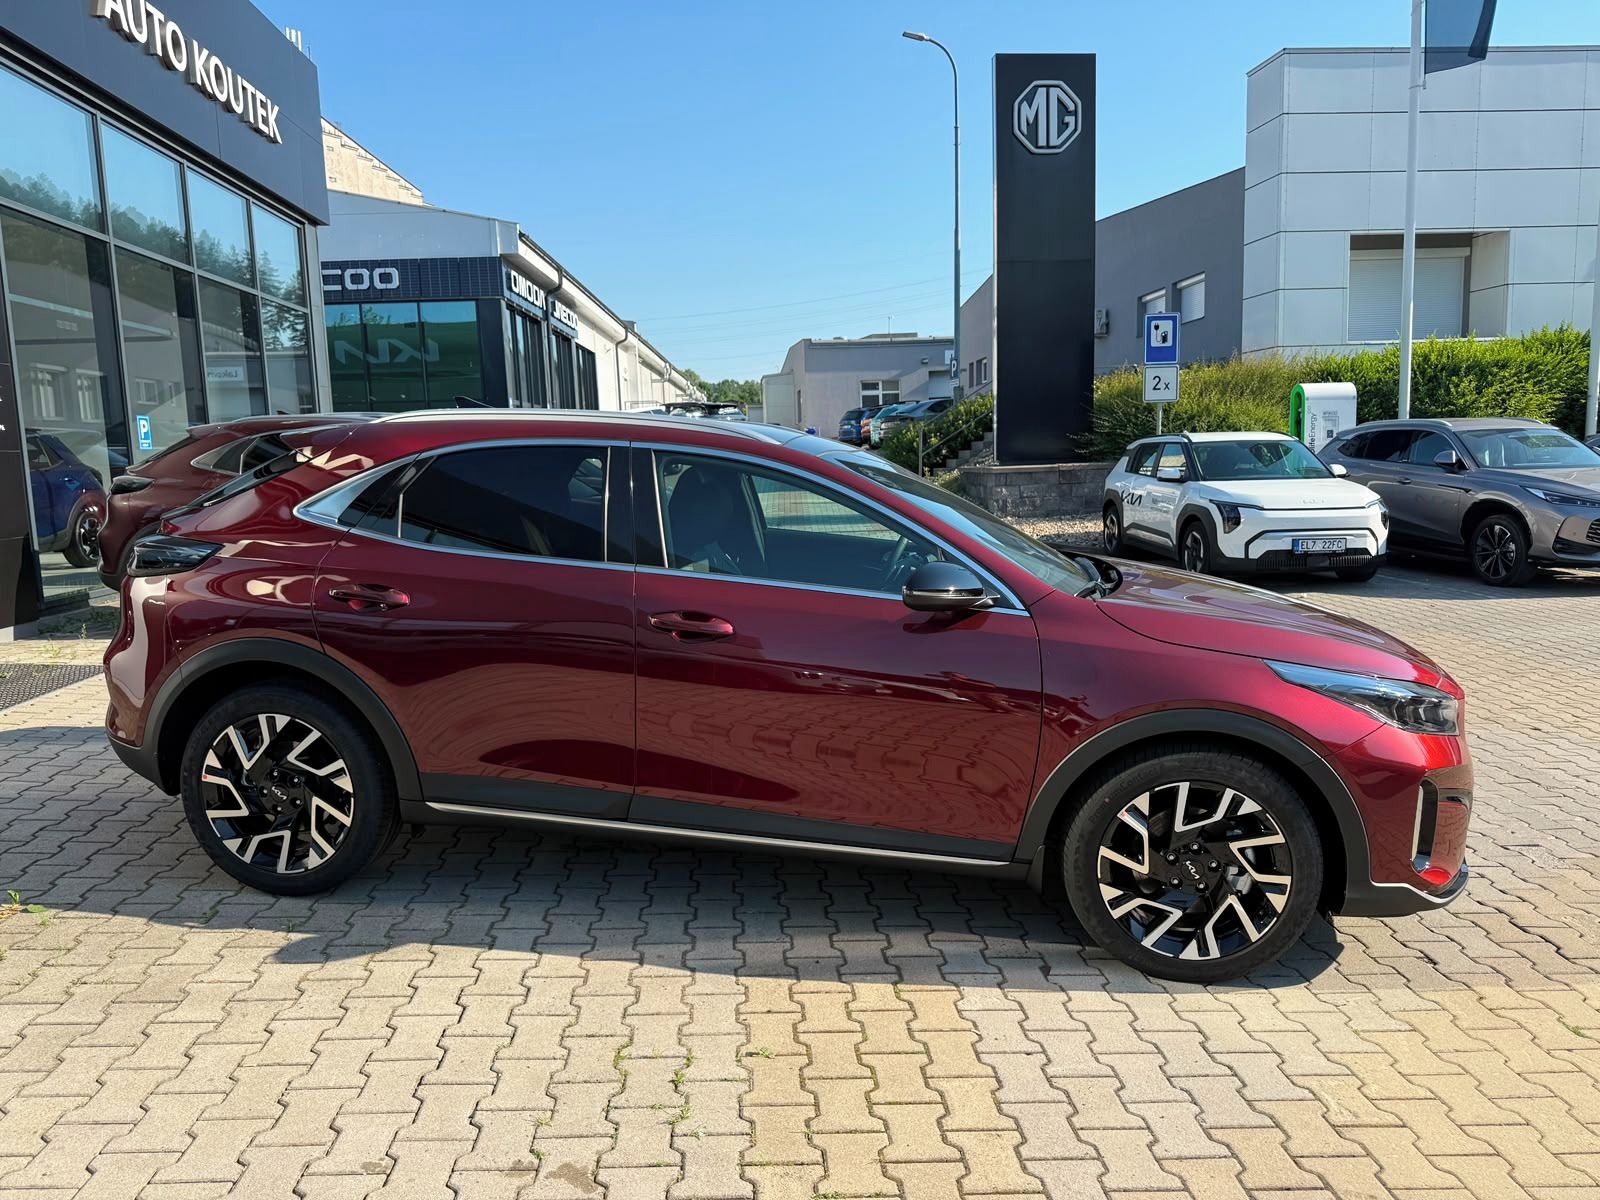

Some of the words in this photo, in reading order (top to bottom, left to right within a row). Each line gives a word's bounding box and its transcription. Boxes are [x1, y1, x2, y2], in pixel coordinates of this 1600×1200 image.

[104, 0, 188, 72] AUTO
[192, 39, 283, 145] KOUTEK
[1020, 87, 1076, 147] MG
[511, 269, 547, 311] OMODA
[140, 419, 149, 439] P
[1300, 540, 1317, 550] EL7
[1322, 540, 1342, 549] 22FC
